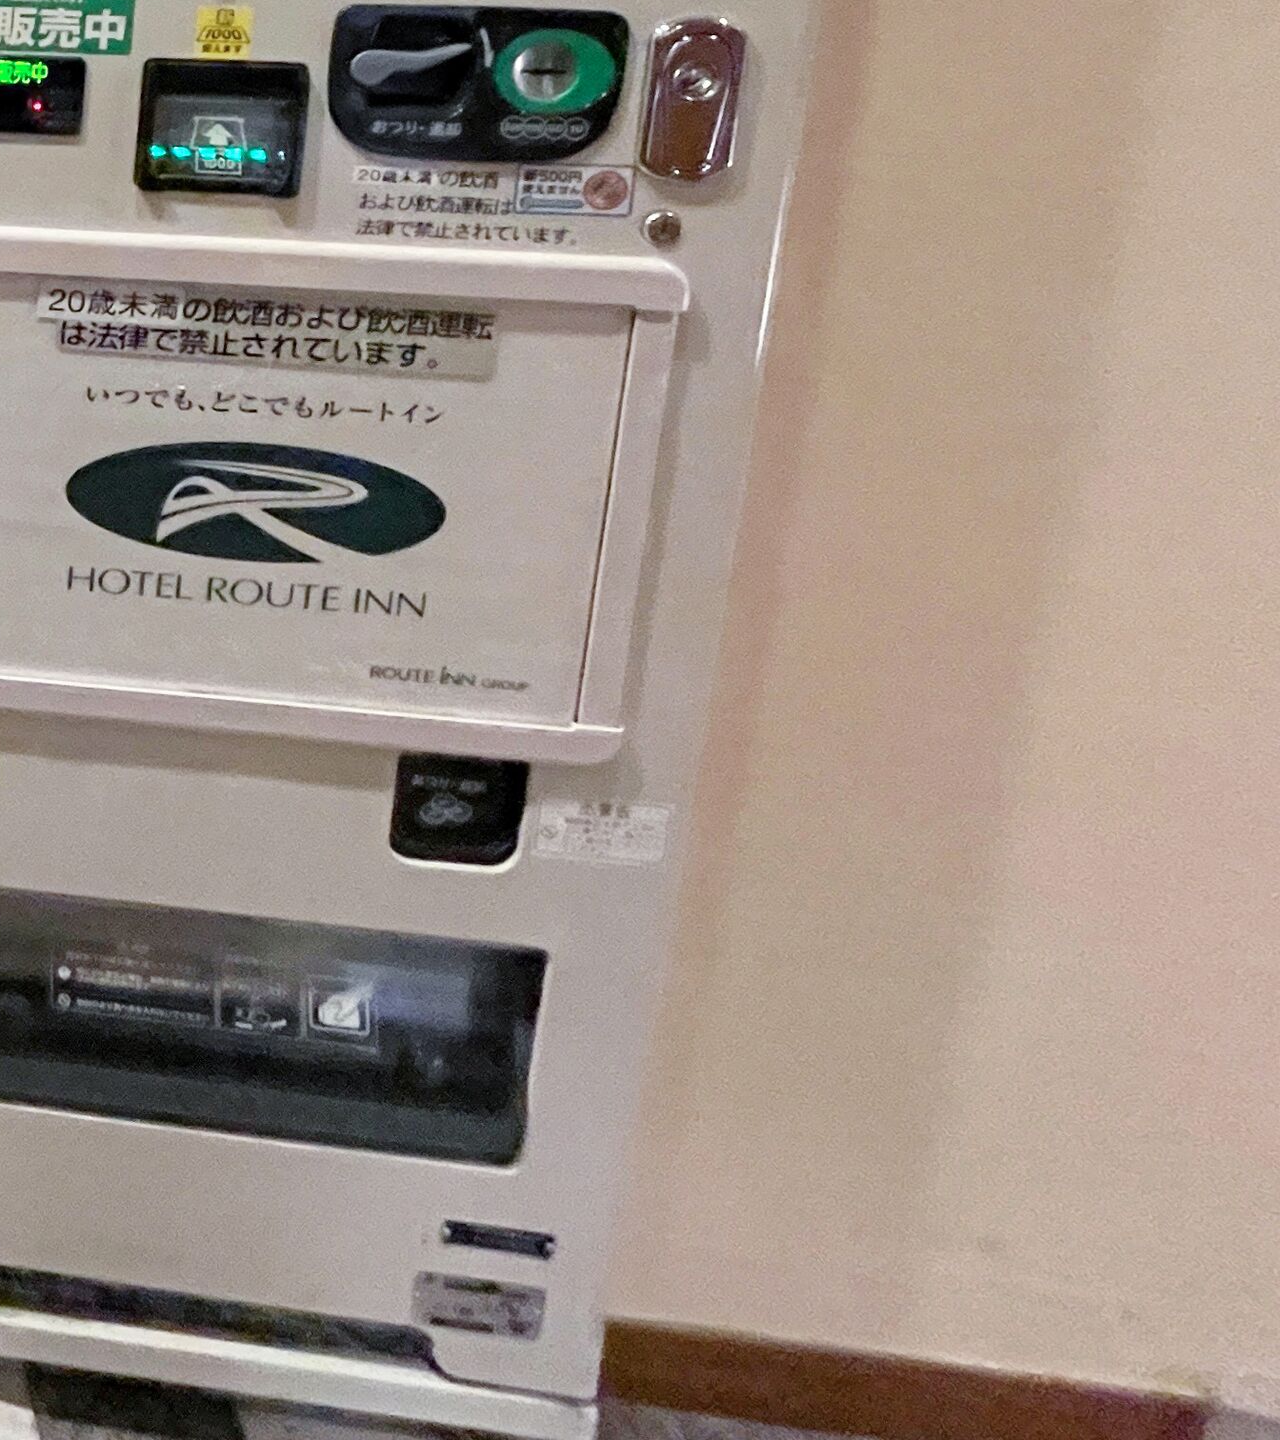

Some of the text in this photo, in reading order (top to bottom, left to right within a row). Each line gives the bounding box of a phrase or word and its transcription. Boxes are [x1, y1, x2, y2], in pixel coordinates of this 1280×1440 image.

[354, 219, 579, 247] 法律で禁止されています。
[46, 286, 494, 342] 20歳未満の飲酒および飲酒運転
[59, 320, 441, 371] は法律で禁止されています。
[85, 383, 446, 425] いつでも、どこでもルートイン
[64, 564, 428, 618] HOTEL ROUTE INN
[369, 663, 436, 686] ROUTE
[439, 664, 478, 687] INN
